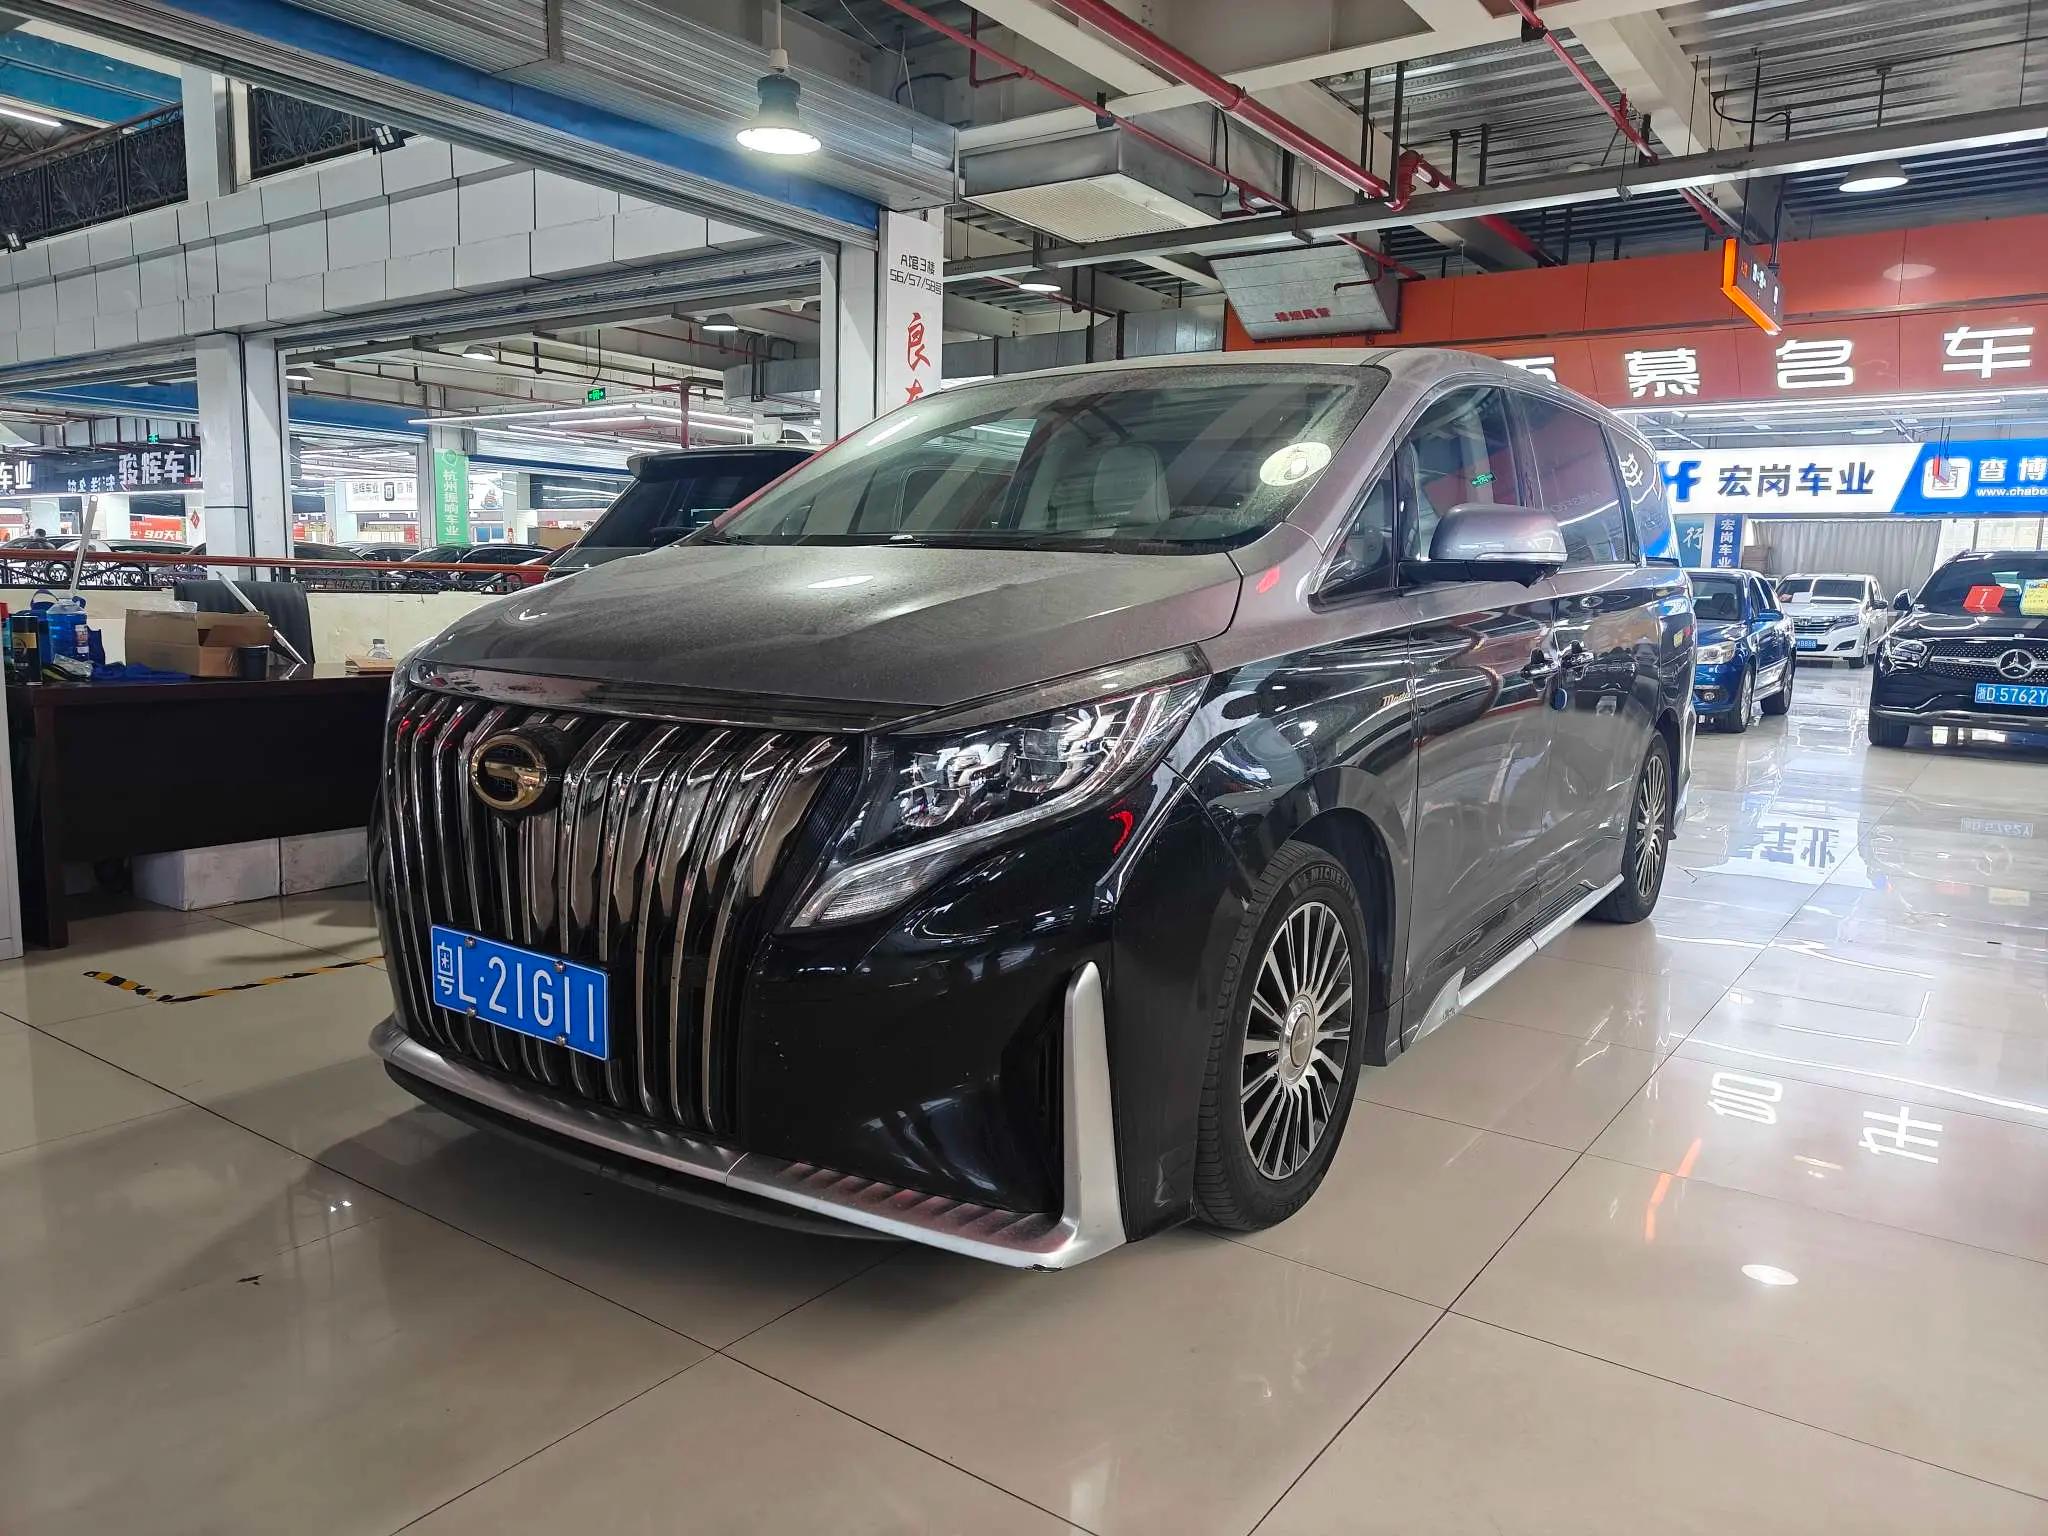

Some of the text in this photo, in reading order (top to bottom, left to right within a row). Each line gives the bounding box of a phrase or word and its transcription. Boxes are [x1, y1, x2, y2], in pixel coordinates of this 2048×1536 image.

[1717, 461, 1875, 498] 宏岗车业
[1716, 518, 1736, 569] 宏岗车业
